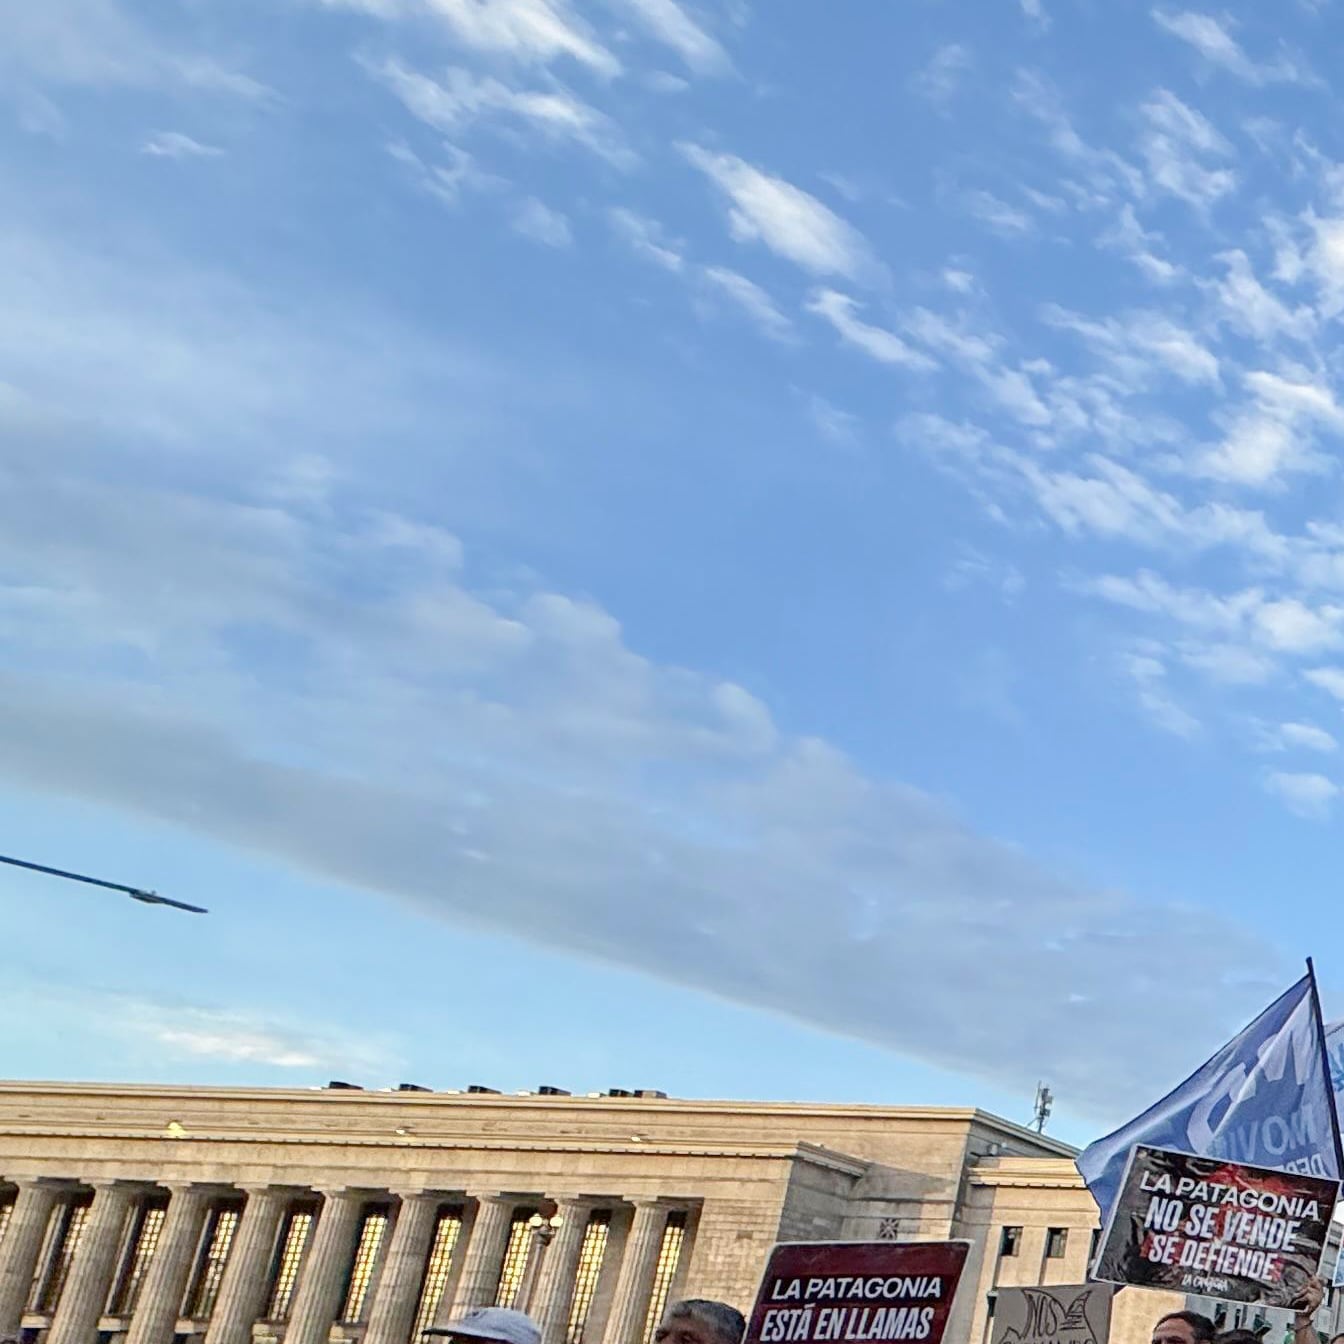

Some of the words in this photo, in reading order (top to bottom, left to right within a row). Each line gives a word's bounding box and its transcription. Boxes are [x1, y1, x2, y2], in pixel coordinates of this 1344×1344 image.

[1140, 1170, 1172, 1194] LA
[1175, 1177, 1321, 1222] PATAGONIA
[1144, 1197, 1184, 1232] NO
[1184, 1204, 1221, 1239] SE
[1222, 1211, 1302, 1252] VENDE
[1148, 1234, 1181, 1265] SE
[1179, 1239, 1279, 1281] DEFIENDE
[772, 1279, 801, 1300] LA
[804, 1276, 942, 1300] PATAGONIA
[759, 1303, 817, 1342] ESTÁ
[813, 1308, 847, 1341] EN
[844, 1306, 935, 1341] LLAMAS
